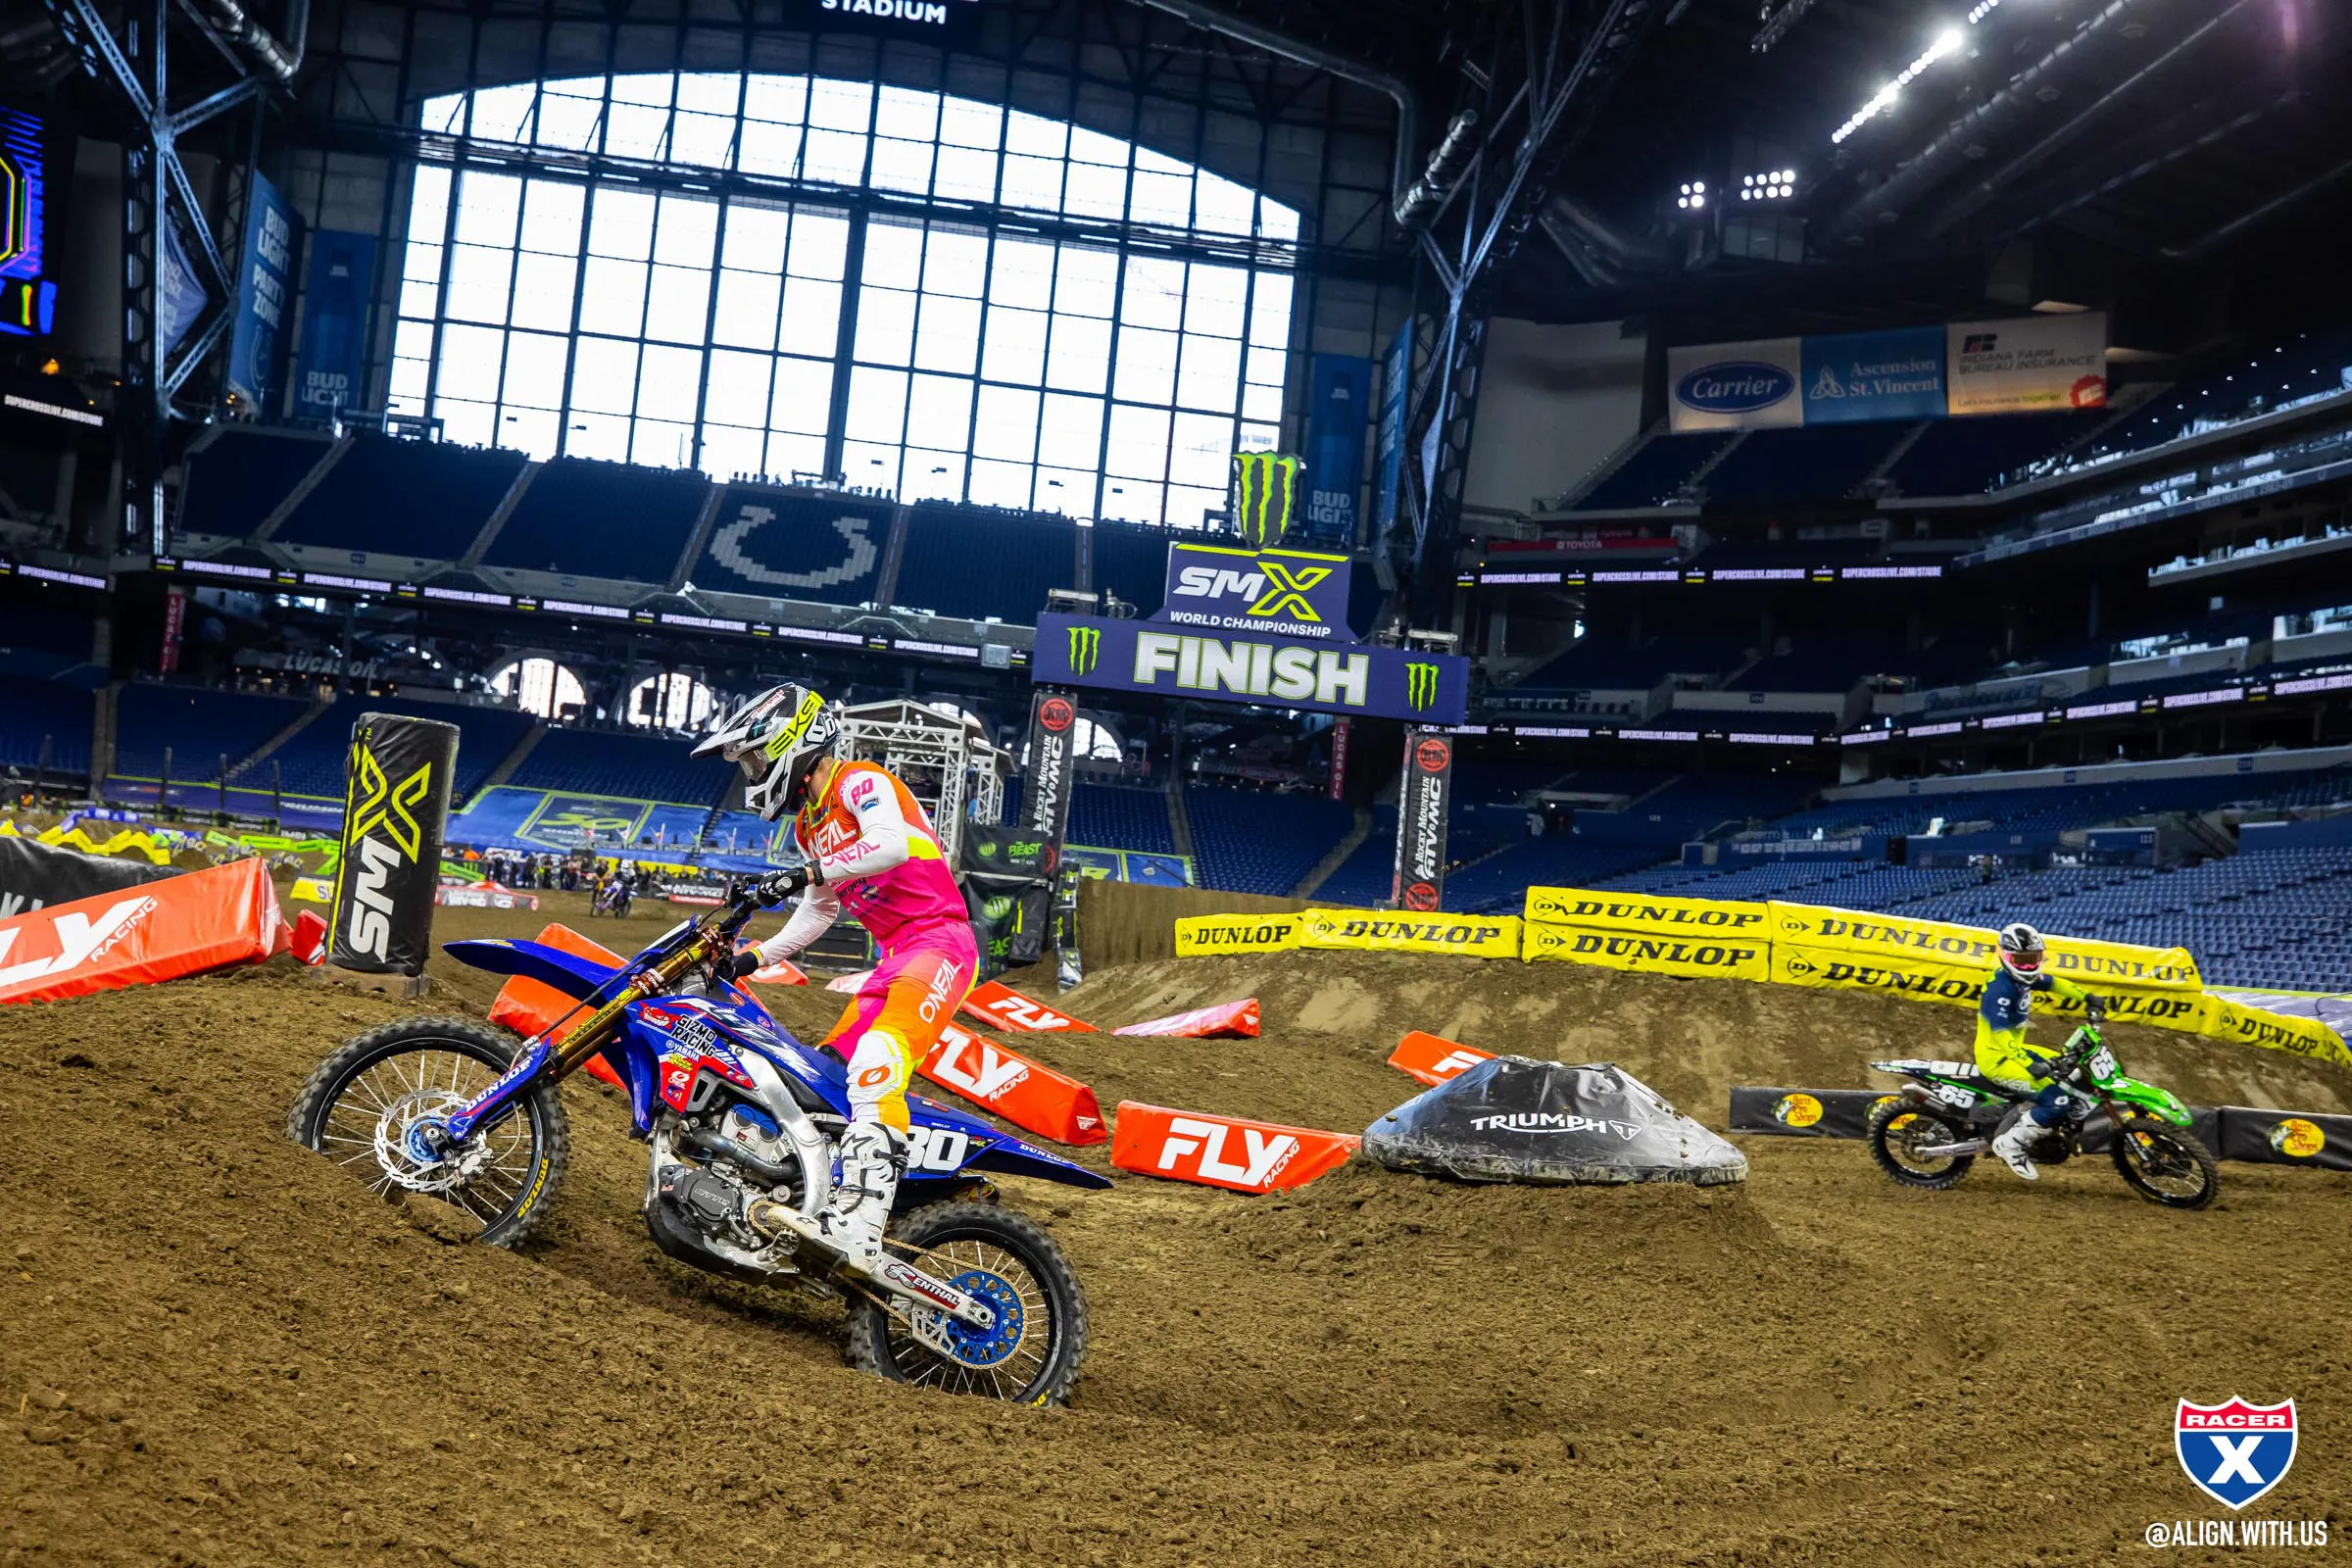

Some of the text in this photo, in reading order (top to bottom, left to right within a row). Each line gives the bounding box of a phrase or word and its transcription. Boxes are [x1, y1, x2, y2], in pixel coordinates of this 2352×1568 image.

[821, 0, 947, 24] STADIUM
[307, 370, 347, 389] BUD
[1851, 359, 1936, 377] Ascension
[1692, 374, 1779, 400] Carrier
[1874, 376, 1940, 395] Vincent
[1313, 490, 1350, 509] BUD
[1172, 562, 1333, 622] SMX
[1170, 611, 1331, 637] WORLD CHAMPIONSHIP
[1134, 631, 1369, 707] FINISH
[1037, 734, 1053, 788] MOUNTAIN
[1335, 726, 1347, 770] LUCAS
[850, 777, 873, 806] 80
[1418, 775, 1431, 829] MOUNTAIN
[350, 745, 431, 963] SMX
[808, 818, 856, 860] NEAL
[1008, 842, 1043, 857] BEAST
[1573, 901, 1763, 928] DUNLOP
[0, 895, 158, 986] LY RACING
[1195, 925, 1292, 946] DUNLOP
[1341, 921, 1500, 945] DUNLOP
[1818, 919, 1997, 958] DUNLOP
[1571, 935, 1755, 966] DUNLOP
[2057, 953, 2195, 982] DUNLOP
[988, 996, 1070, 1029] FLY
[2055, 996, 2192, 1018] DNLOP
[671, 1026, 716, 1057] RACING
[676, 1013, 718, 1043] GIZMO
[2238, 1017, 2318, 1054] DUNLOP
[673, 1044, 700, 1062] YAMAHA
[466, 1058, 533, 1112] DUNLOP
[989, 1069, 1030, 1102] RACING
[1938, 1085, 1976, 1108] 65
[1470, 1112, 1607, 1134] TRIUMPH
[905, 1126, 969, 1170] 80
[1019, 1143, 1072, 1164] DUNLOP
[1157, 1118, 1300, 1188] FLY RACING
[516, 1157, 549, 1218] DUNLOP
